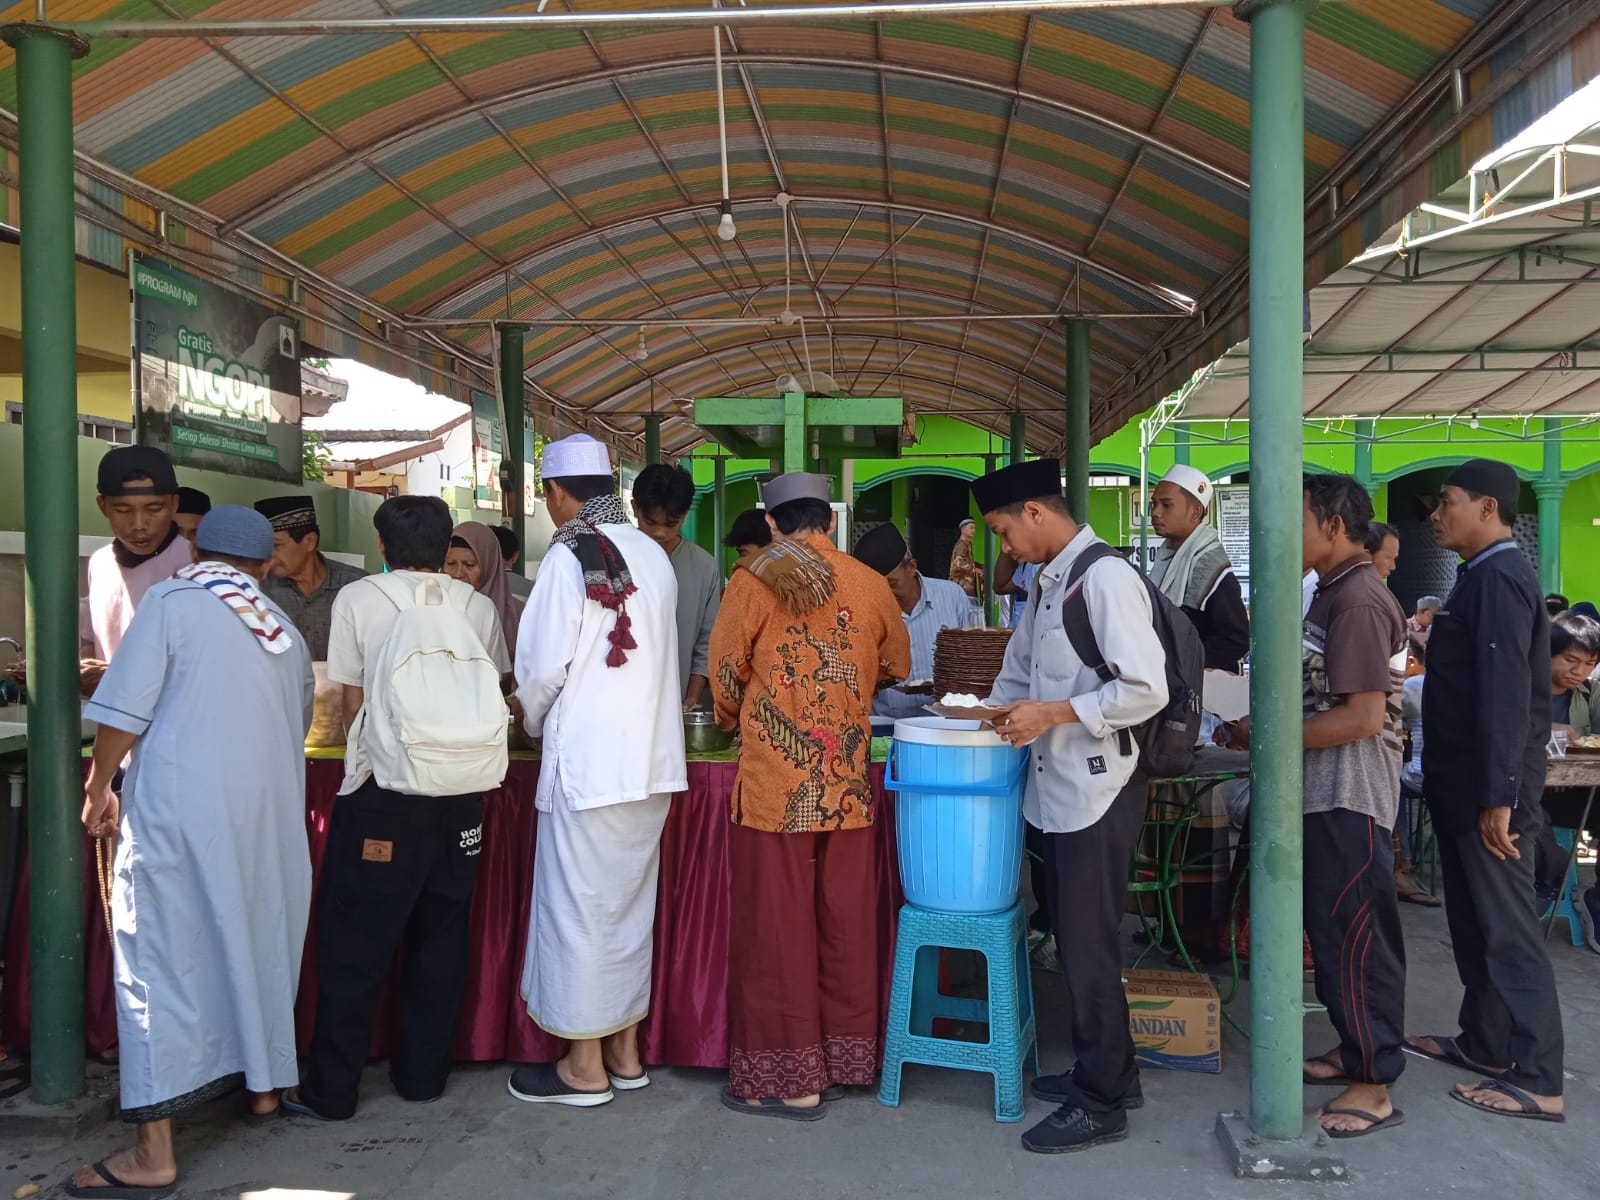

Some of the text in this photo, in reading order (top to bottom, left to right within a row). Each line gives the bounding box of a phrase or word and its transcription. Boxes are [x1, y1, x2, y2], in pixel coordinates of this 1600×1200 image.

[137, 271, 181, 300] #PROGRAM
[178, 328, 212, 353] Gratis
[178, 347, 272, 419] NGOPI
[177, 429, 198, 445] Setiap
